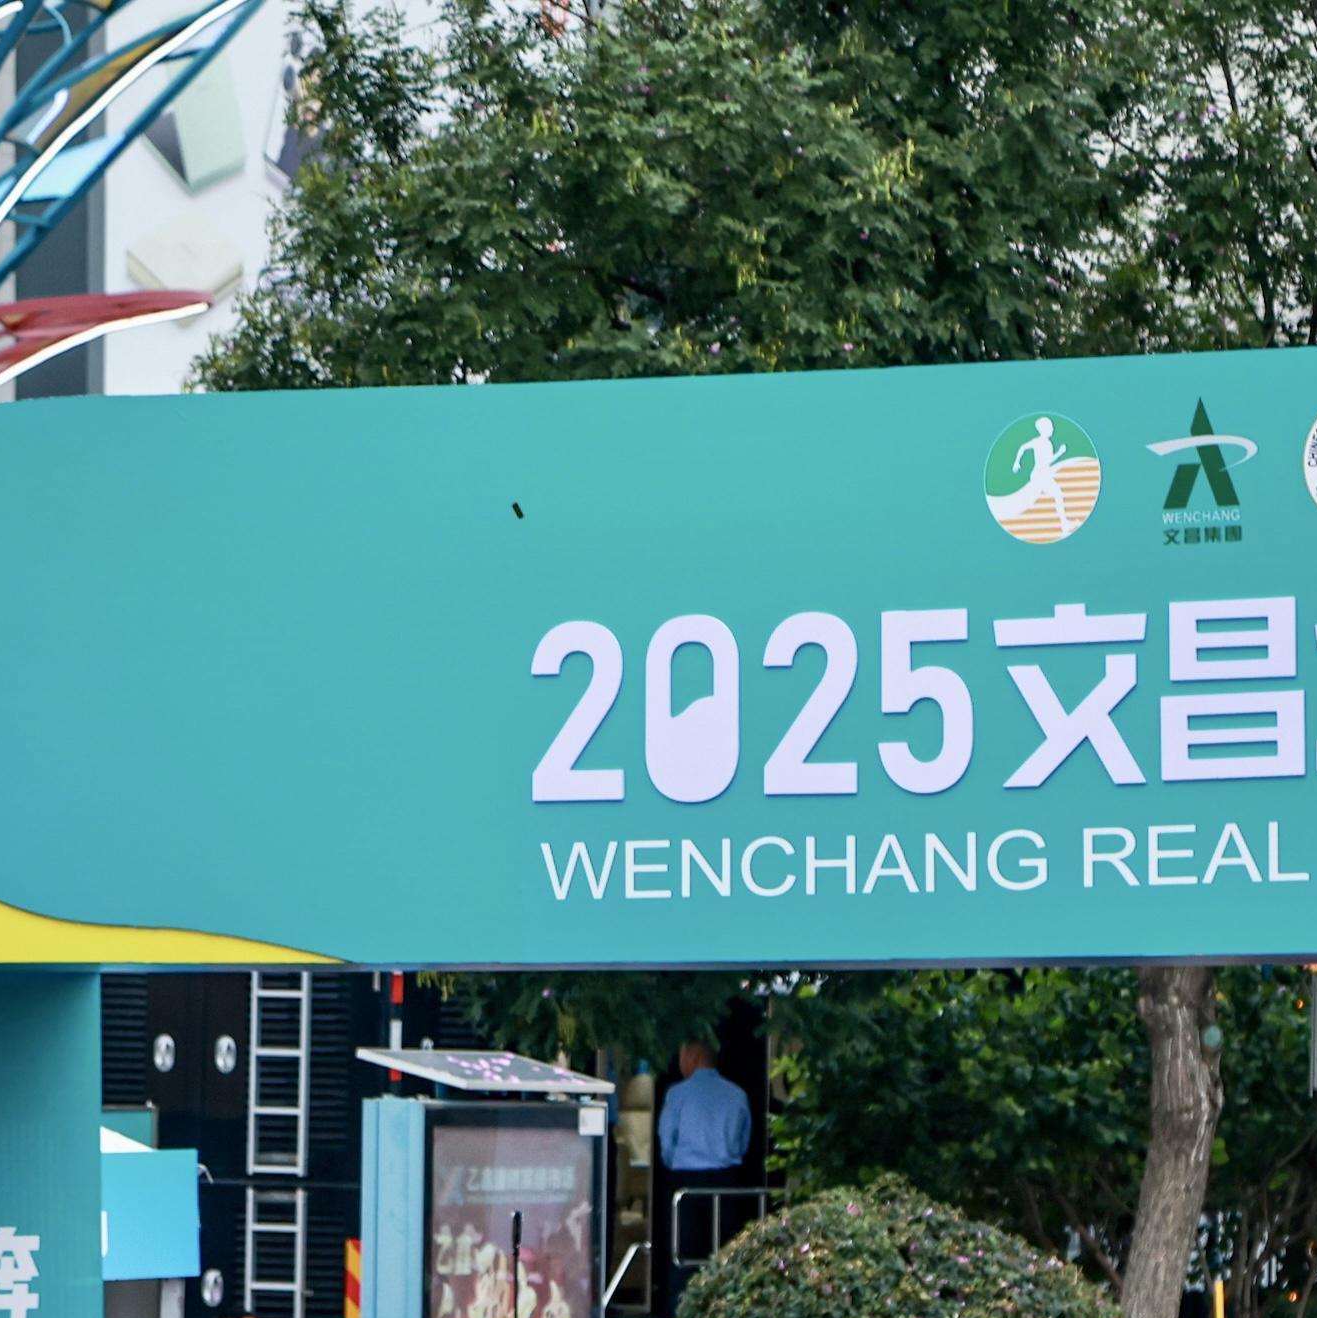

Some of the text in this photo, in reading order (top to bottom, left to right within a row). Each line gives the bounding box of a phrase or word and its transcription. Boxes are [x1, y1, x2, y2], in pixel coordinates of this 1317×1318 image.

[1161, 508, 1241, 525] WENCHANG
[540, 828, 1049, 901] WENCHANG
[1081, 821, 1309, 889] REAL
